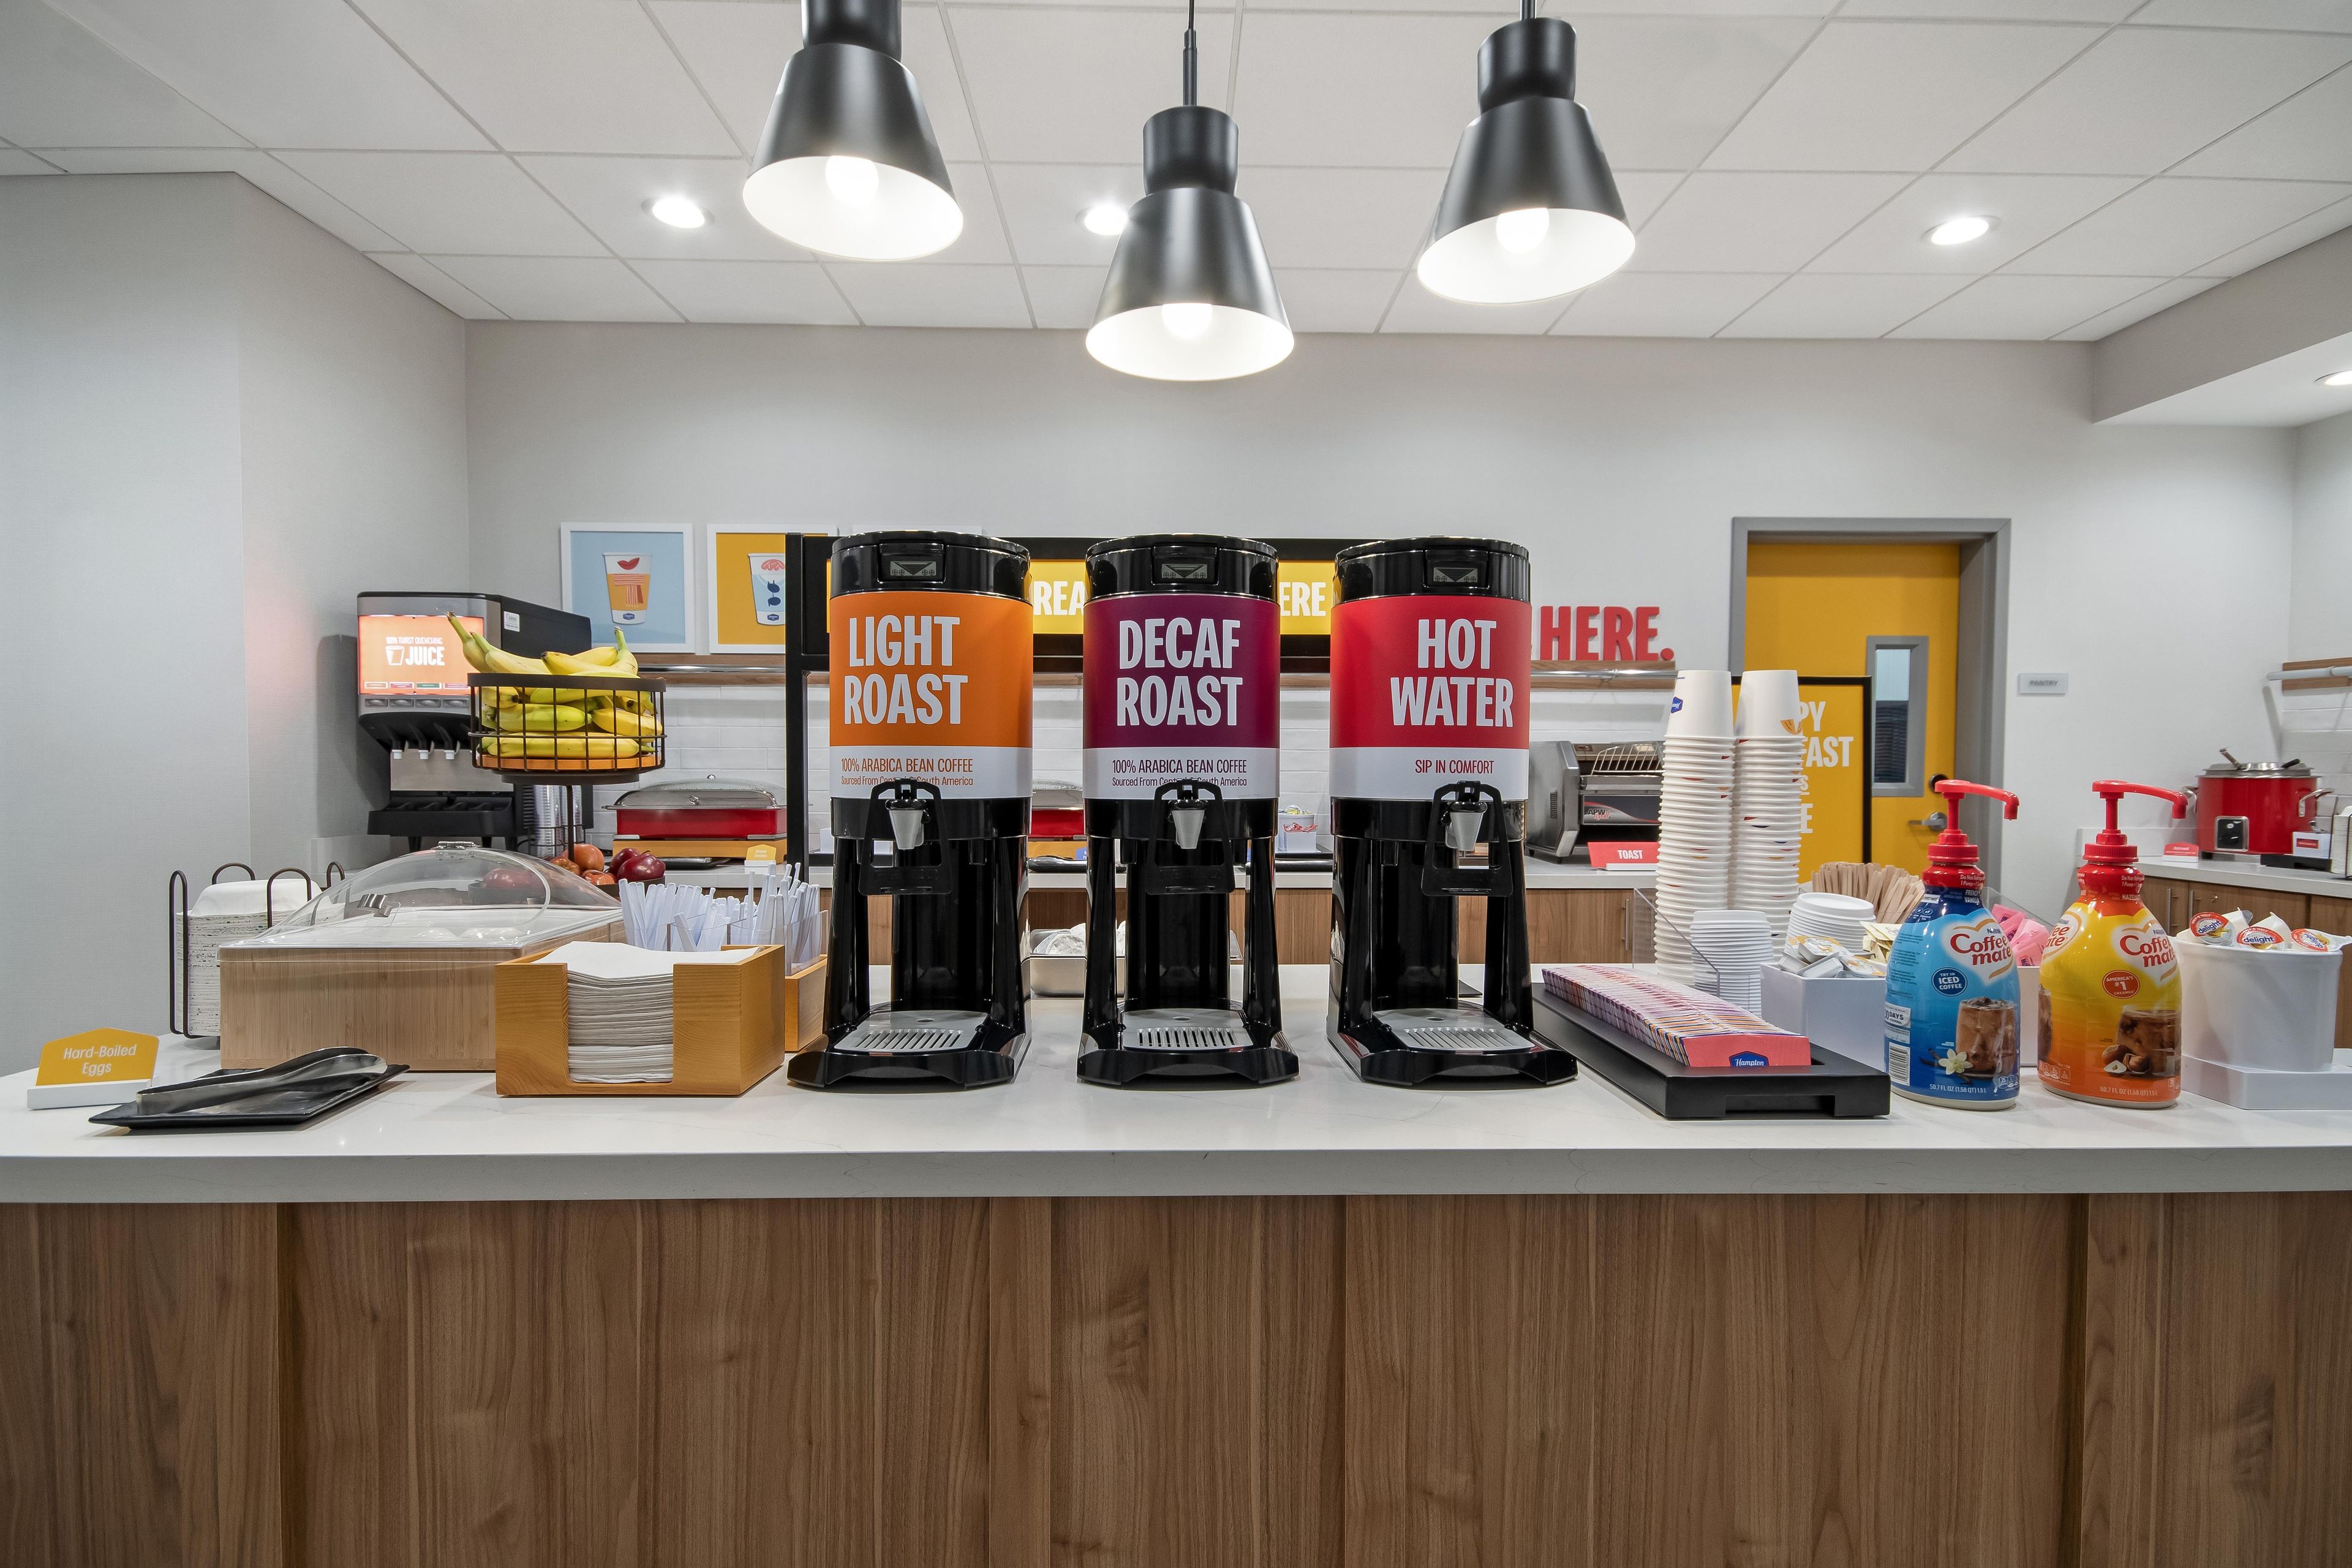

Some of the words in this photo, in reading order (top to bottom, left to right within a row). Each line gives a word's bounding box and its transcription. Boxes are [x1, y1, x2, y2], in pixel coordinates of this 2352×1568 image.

[850, 614, 960, 667] LIGHT
[1540, 606, 1675, 661] HERE.
[1120, 617, 1240, 669] DECAF
[1418, 618, 1497, 669] HOT
[405, 646, 445, 666] JUICE
[845, 673, 968, 725] ROAST
[1117, 676, 1243, 726] ROAST
[1390, 676, 1513, 728] WATER
[841, 758, 860, 772] 100%
[861, 758, 903, 772] ARABICA
[906, 758, 934, 772] BEAN
[938, 758, 973, 772] COFFEE
[1112, 760, 1136, 774] 100%
[1139, 760, 1183, 773] ARABICA
[1186, 760, 1213, 773] BEAN
[1216, 760, 1247, 773] COFFEE
[1415, 760, 1432, 774] SIP
[1436, 760, 1446, 774] IN
[1449, 760, 1494, 774] COMFORT
[841, 775, 861, 785] Sourced
[862, 776, 878, 785] From
[941, 776, 973, 786] America
[1112, 777, 1138, 786] Sourced
[1140, 777, 1158, 786] From
[1221, 777, 1247, 786] America
[1617, 850, 1643, 859] TOAST
[2198, 920, 2222, 933] delight
[1950, 933, 2008, 954] Coffee
[1972, 946, 2011, 966] mate
[1938, 976, 1960, 985] ICED
[1889, 1011, 1904, 1020] DAYS
[63, 1044, 137, 1060] Hard-Boiled
[81, 1062, 111, 1076] Eggs
[1735, 1058, 1765, 1066] Hampton
